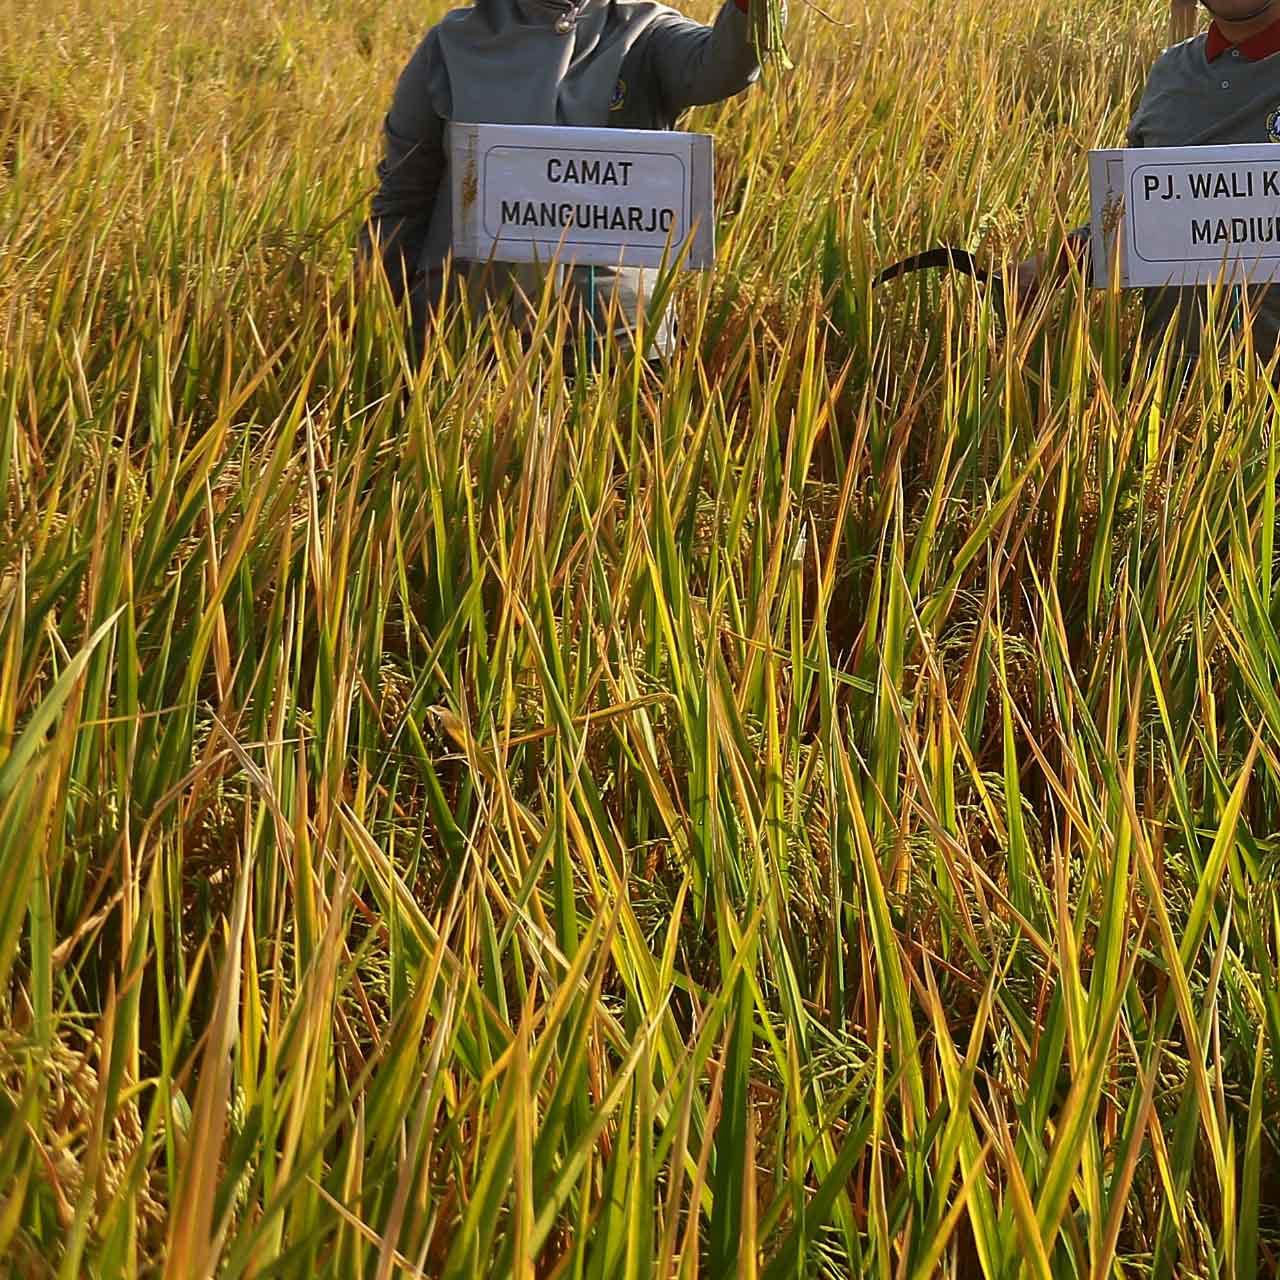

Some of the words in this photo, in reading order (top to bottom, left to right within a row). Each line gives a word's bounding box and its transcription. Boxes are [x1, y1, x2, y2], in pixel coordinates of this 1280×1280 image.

[547, 158, 632, 186] CAMAT
[1144, 175, 1181, 200] PJ.
[1189, 172, 1252, 199] WALI
[501, 200, 675, 233] MANGUHARJO
